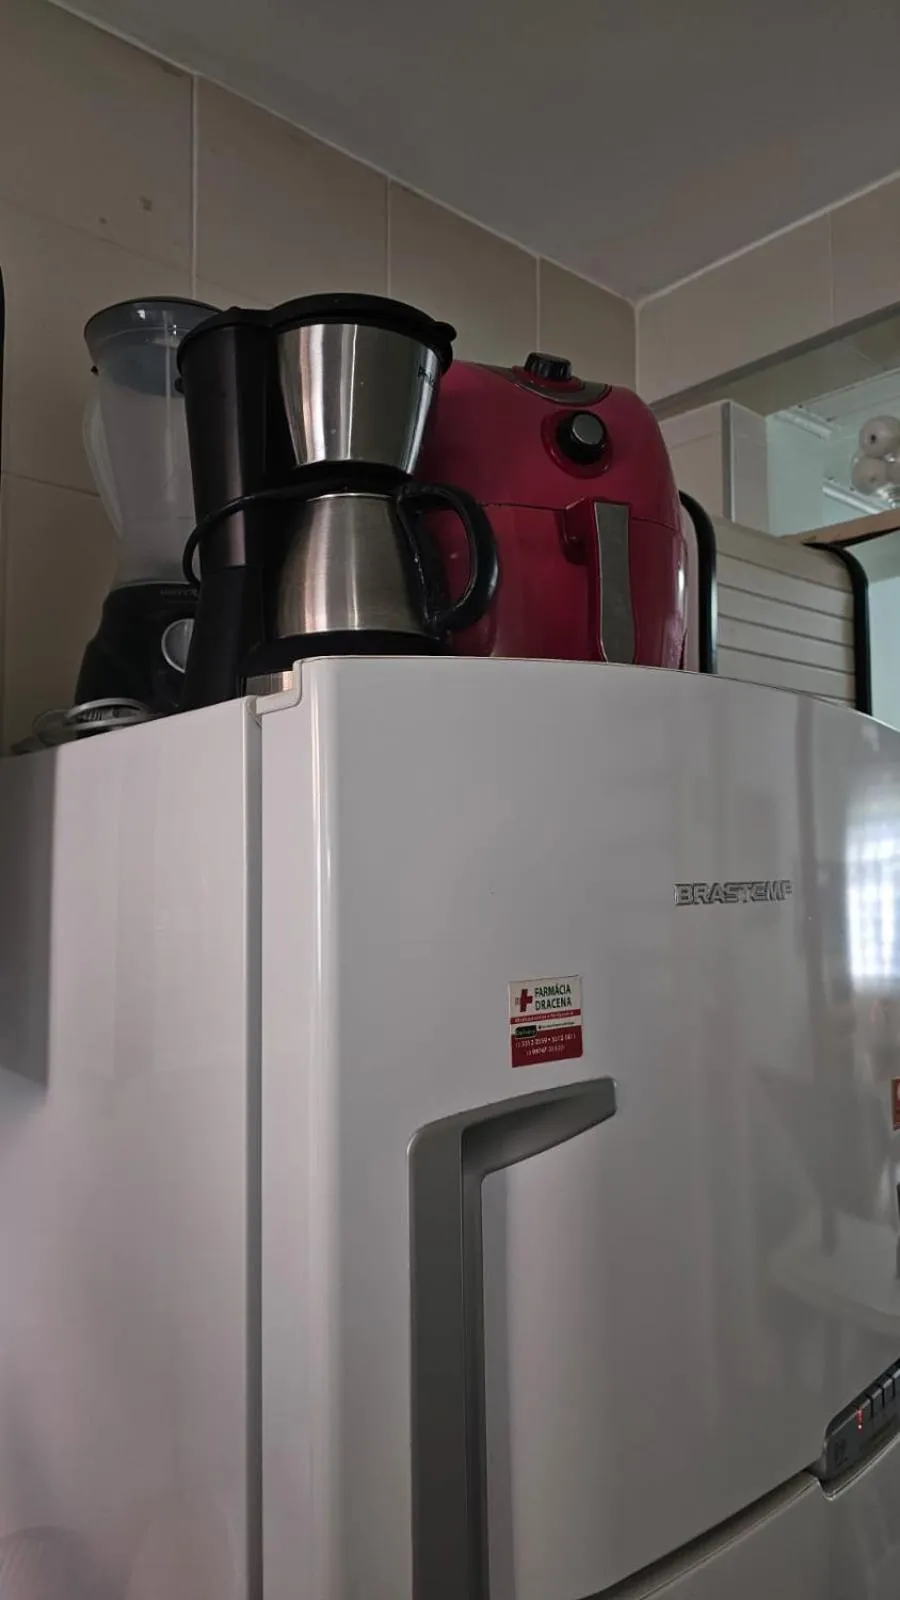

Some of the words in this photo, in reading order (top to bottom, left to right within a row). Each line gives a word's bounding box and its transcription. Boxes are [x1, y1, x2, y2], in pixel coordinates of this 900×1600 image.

[674, 880, 793, 906] BRASTEMP
[534, 983, 572, 997] FARMÁCIA
[535, 997, 573, 1011] DRACENA
